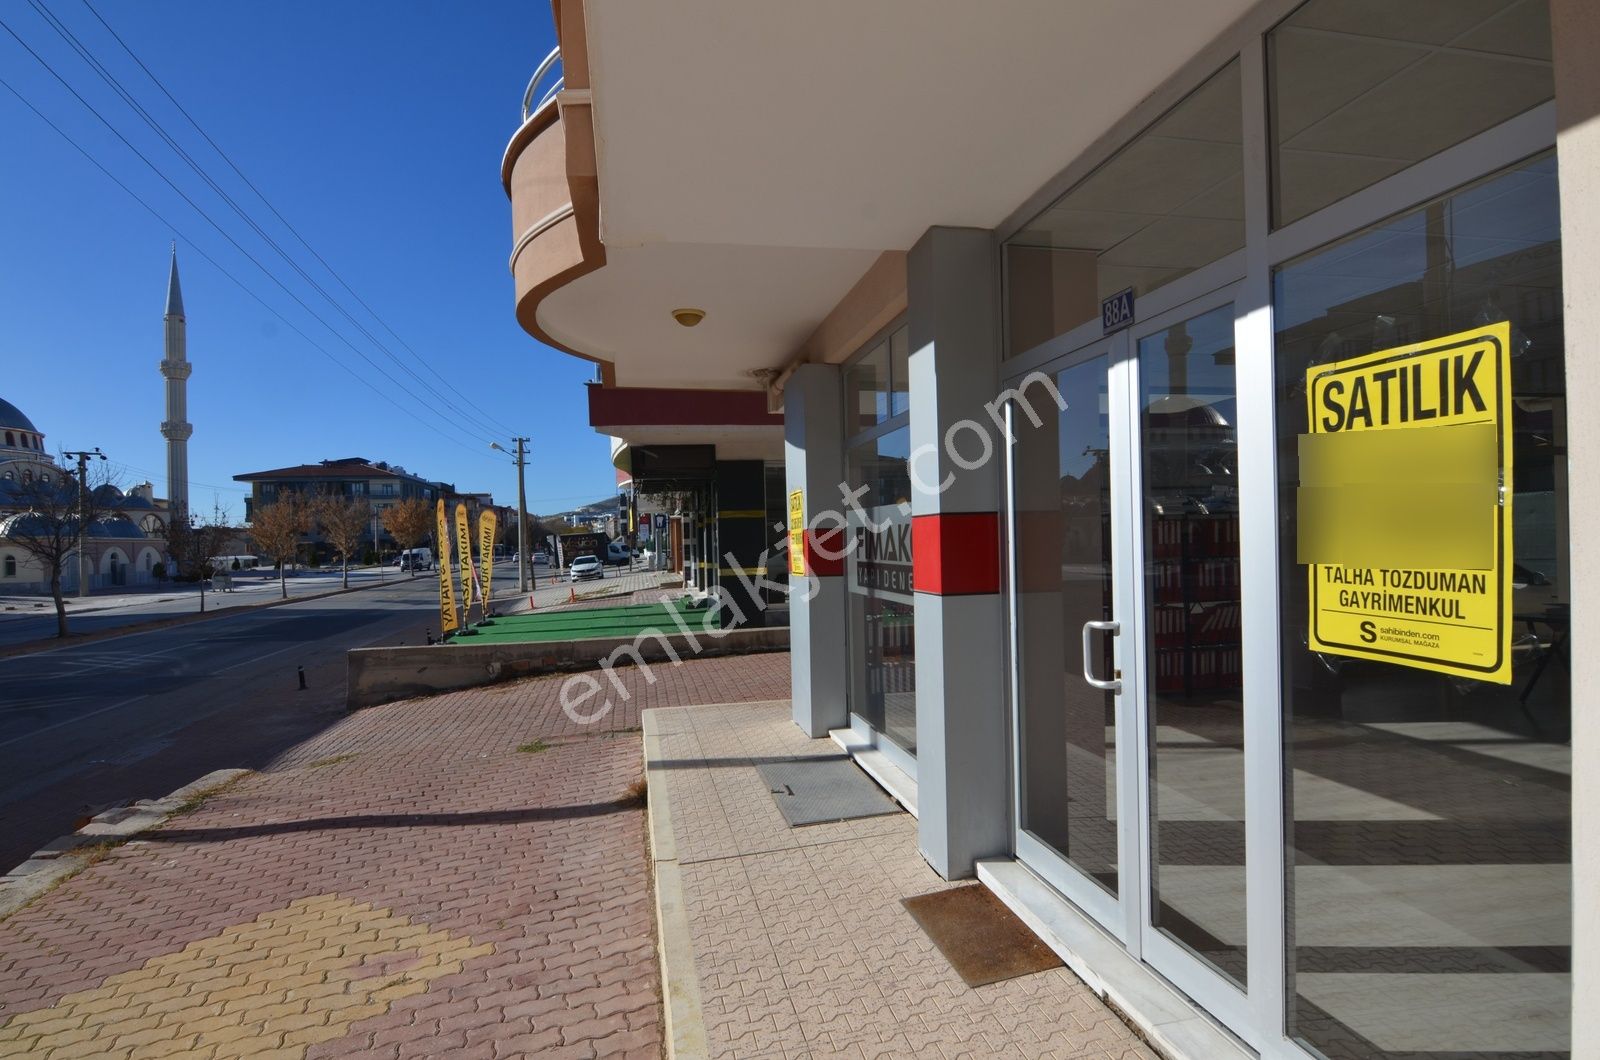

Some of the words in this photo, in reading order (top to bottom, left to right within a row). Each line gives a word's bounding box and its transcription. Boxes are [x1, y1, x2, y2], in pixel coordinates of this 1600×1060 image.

[1105, 294, 1130, 327] 88A
[1322, 350, 1487, 433] SATILIK
[460, 522, 469, 573] TAKIMI
[482, 527, 491, 564] TAKIMI
[859, 568, 880, 586] YAPI
[1324, 566, 1374, 587] TALHA
[1380, 569, 1486, 594] TOZDUMAN
[1339, 589, 1466, 620] GAYRİMENKUL
[1380, 626, 1440, 641] sahibinden.com
[1380, 635, 1412, 646] KURUMSAL
[1414, 638, 1440, 649] MAĞAZA
